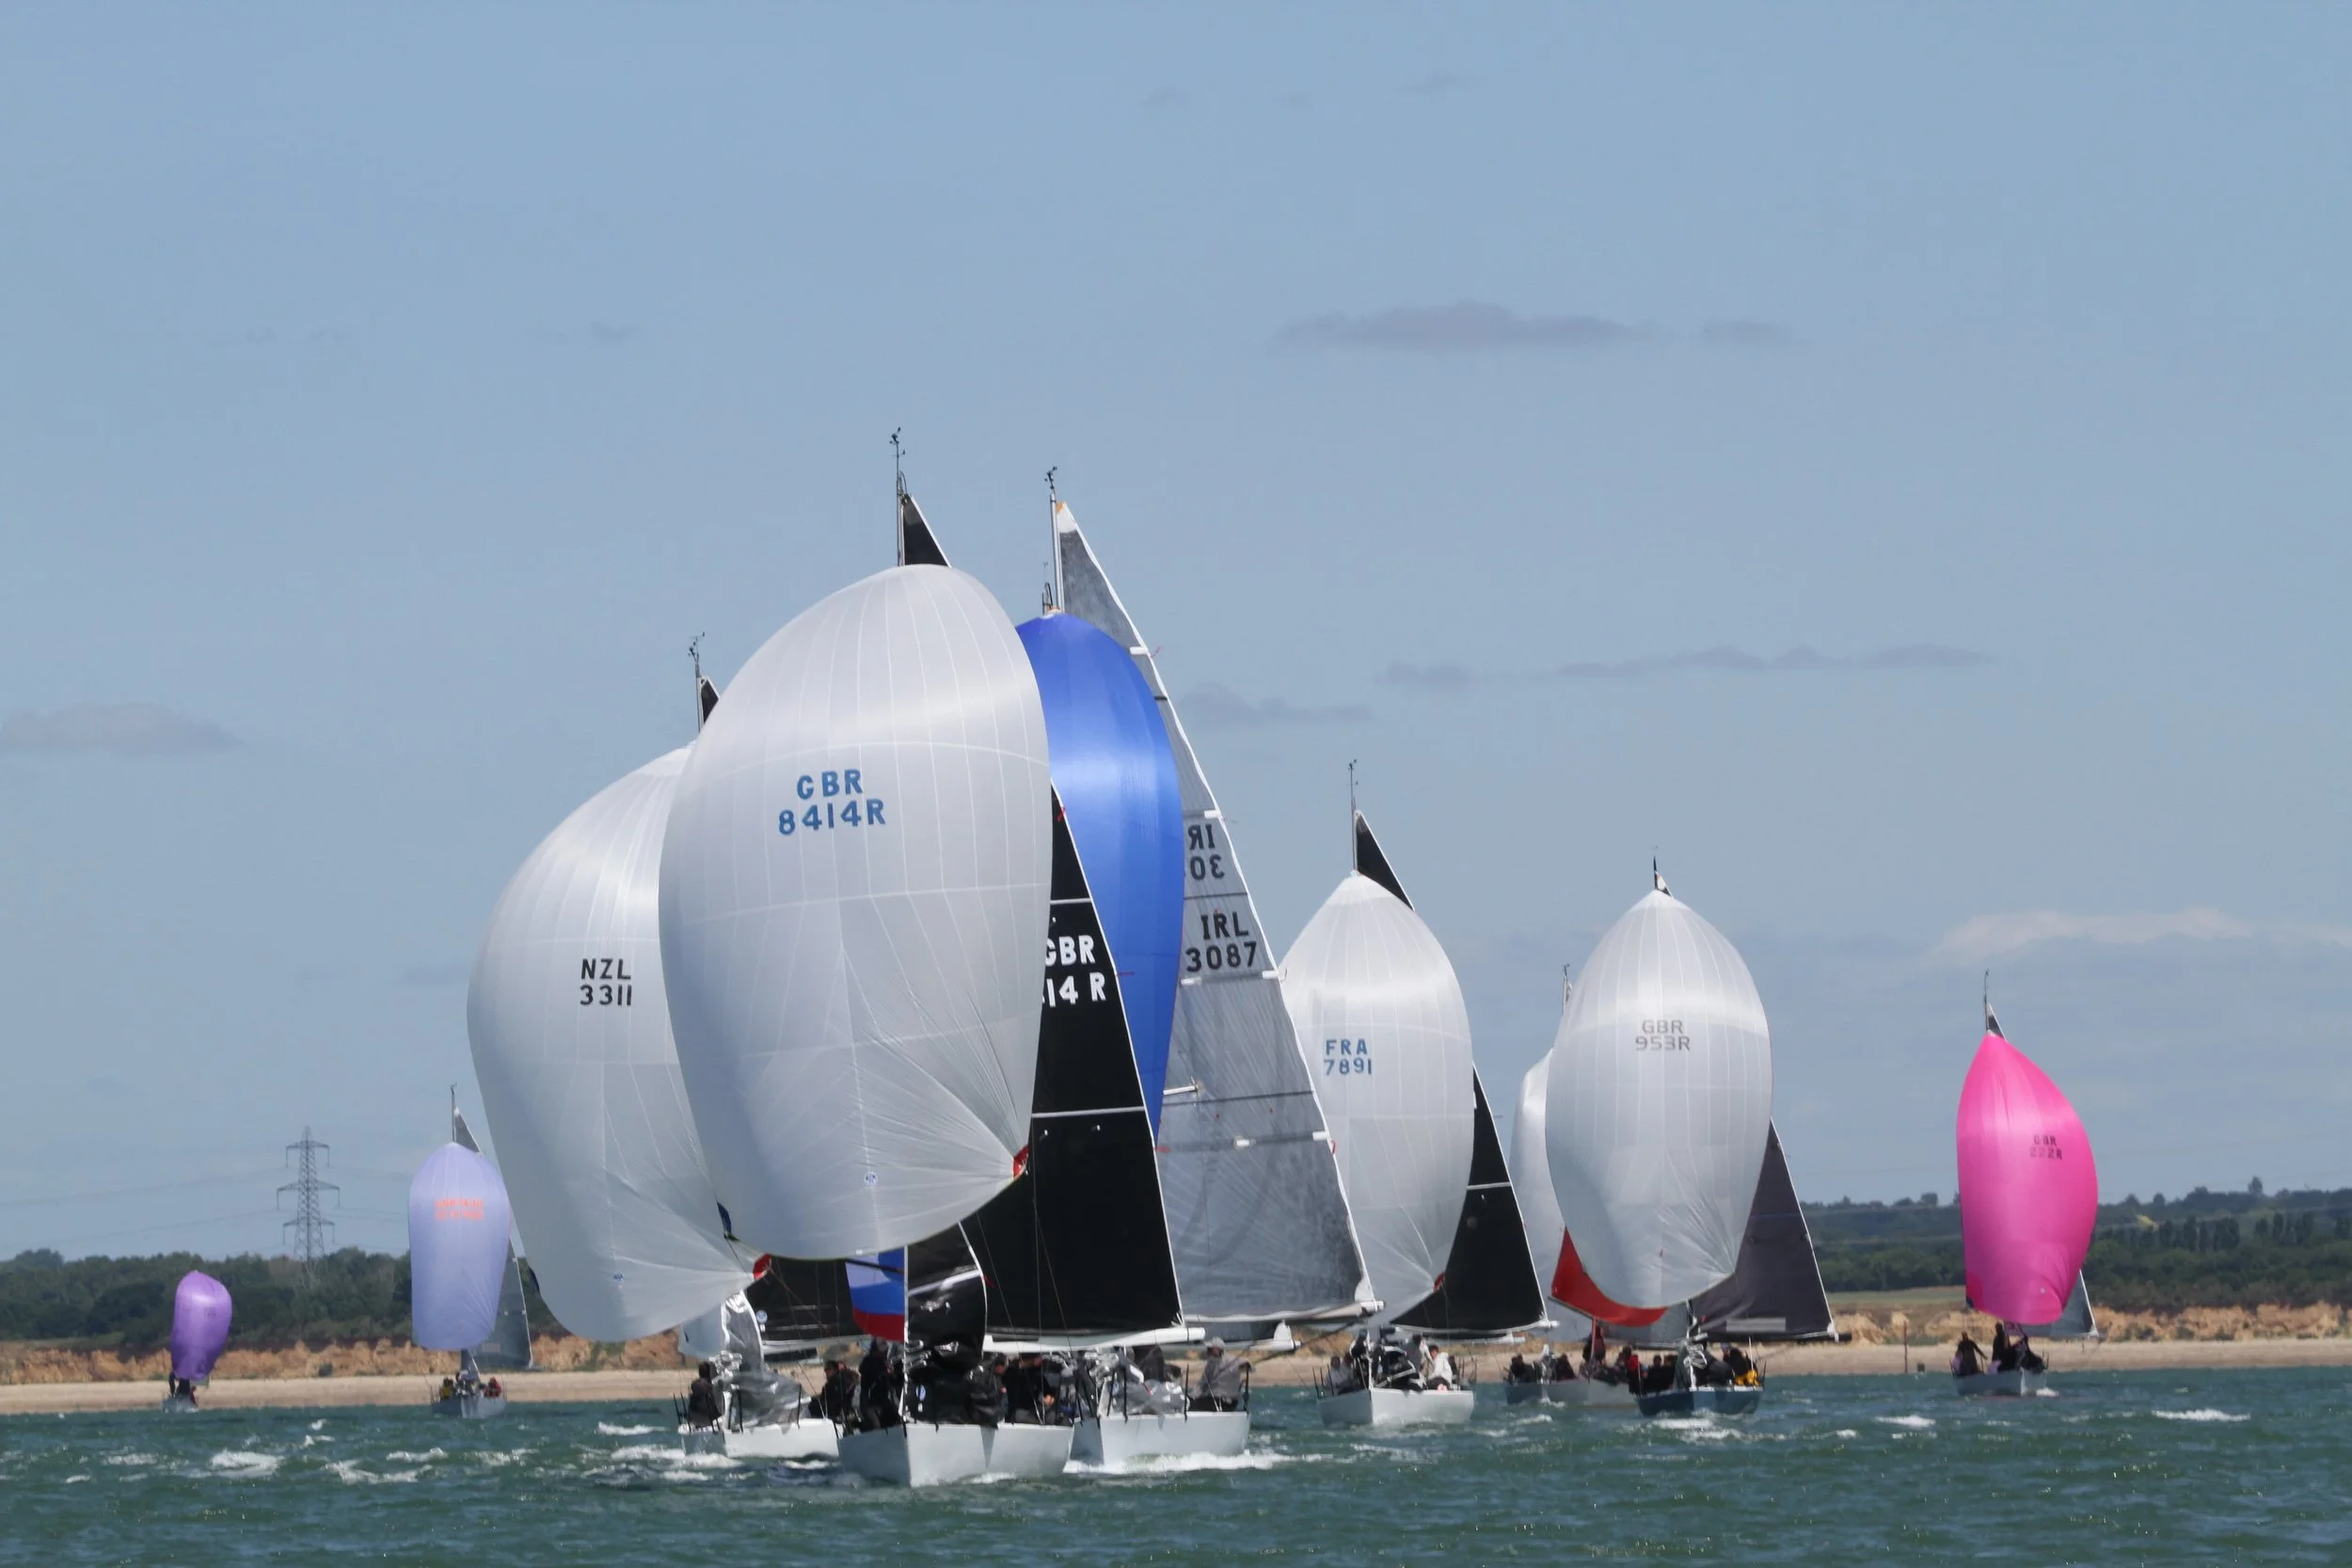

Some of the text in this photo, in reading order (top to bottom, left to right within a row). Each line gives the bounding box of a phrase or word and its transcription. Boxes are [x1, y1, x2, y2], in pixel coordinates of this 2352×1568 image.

[796, 768, 864, 800] GBR
[778, 798, 886, 836] 8414R
[1200, 911, 1249, 942] IRL
[1185, 941, 1258, 973] 3087
[580, 958, 632, 980] NZL
[580, 983, 632, 1006] 3311
[1642, 1019, 1684, 1035] GBR
[1326, 1038, 1368, 1055] FRA
[1635, 1035, 1691, 1053] 953R
[1324, 1057, 1373, 1076] 7891
